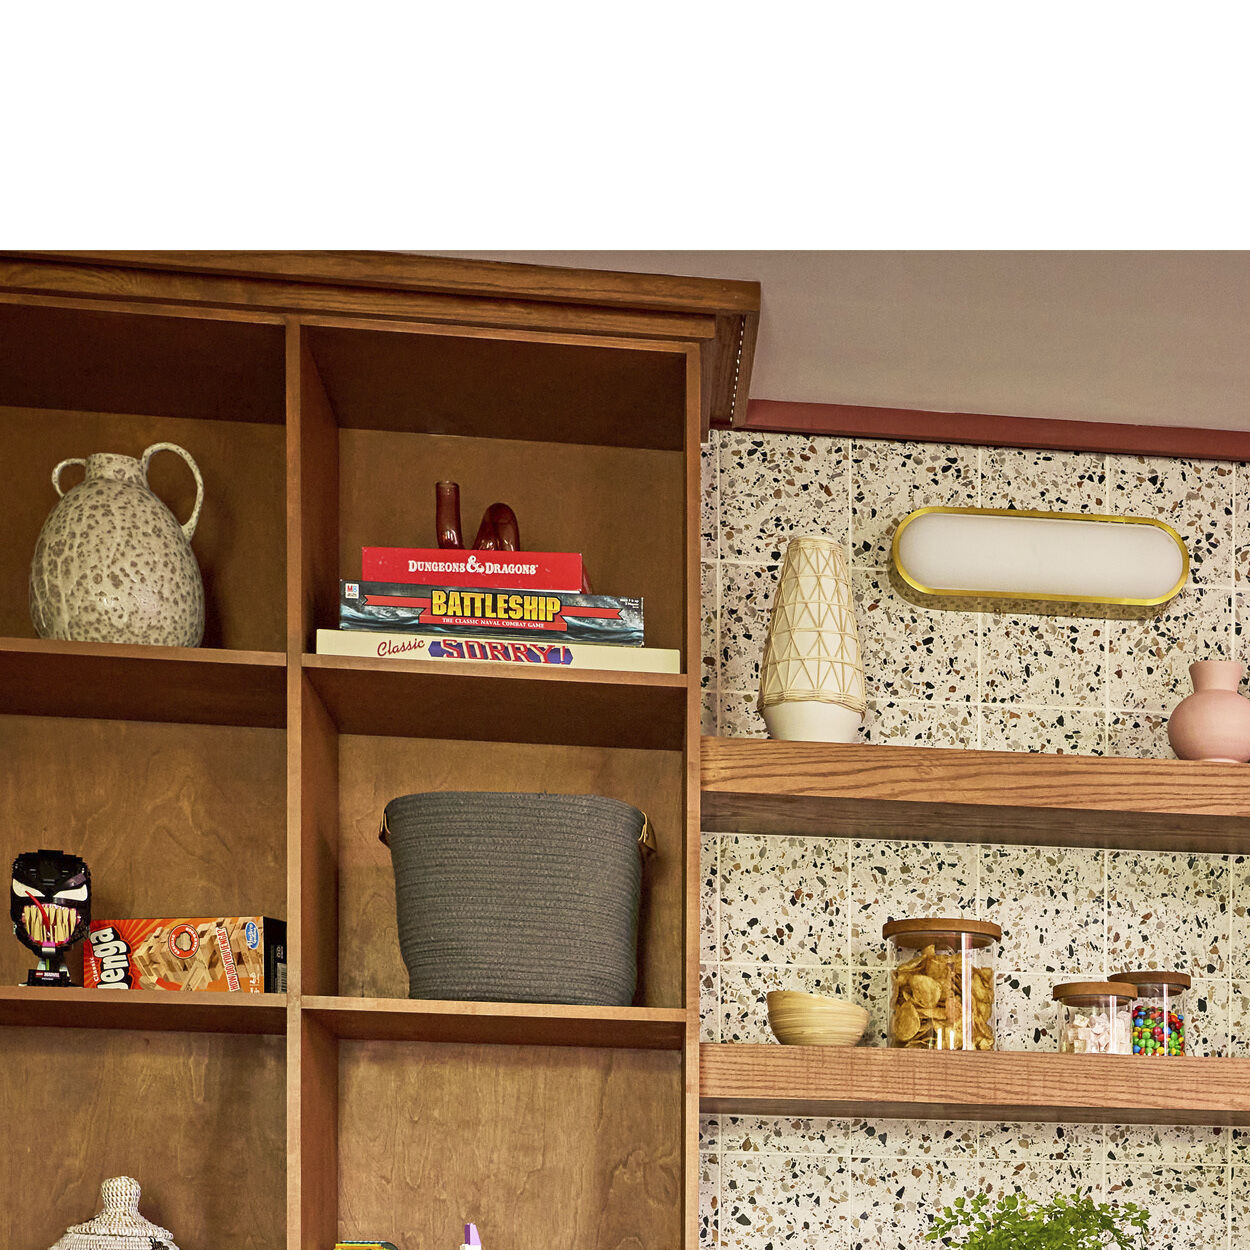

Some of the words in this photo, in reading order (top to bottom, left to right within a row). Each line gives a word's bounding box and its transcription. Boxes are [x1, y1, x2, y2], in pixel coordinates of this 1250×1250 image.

[408, 559, 466, 573] DUNGEONS
[466, 554, 485, 574] &
[485, 561, 536, 575] DRAGONS
[431, 588, 562, 622] BATTLESHIP
[502, 620, 527, 628] COMBAT
[376, 638, 425, 657] Classic
[441, 638, 567, 666] SORRY!
